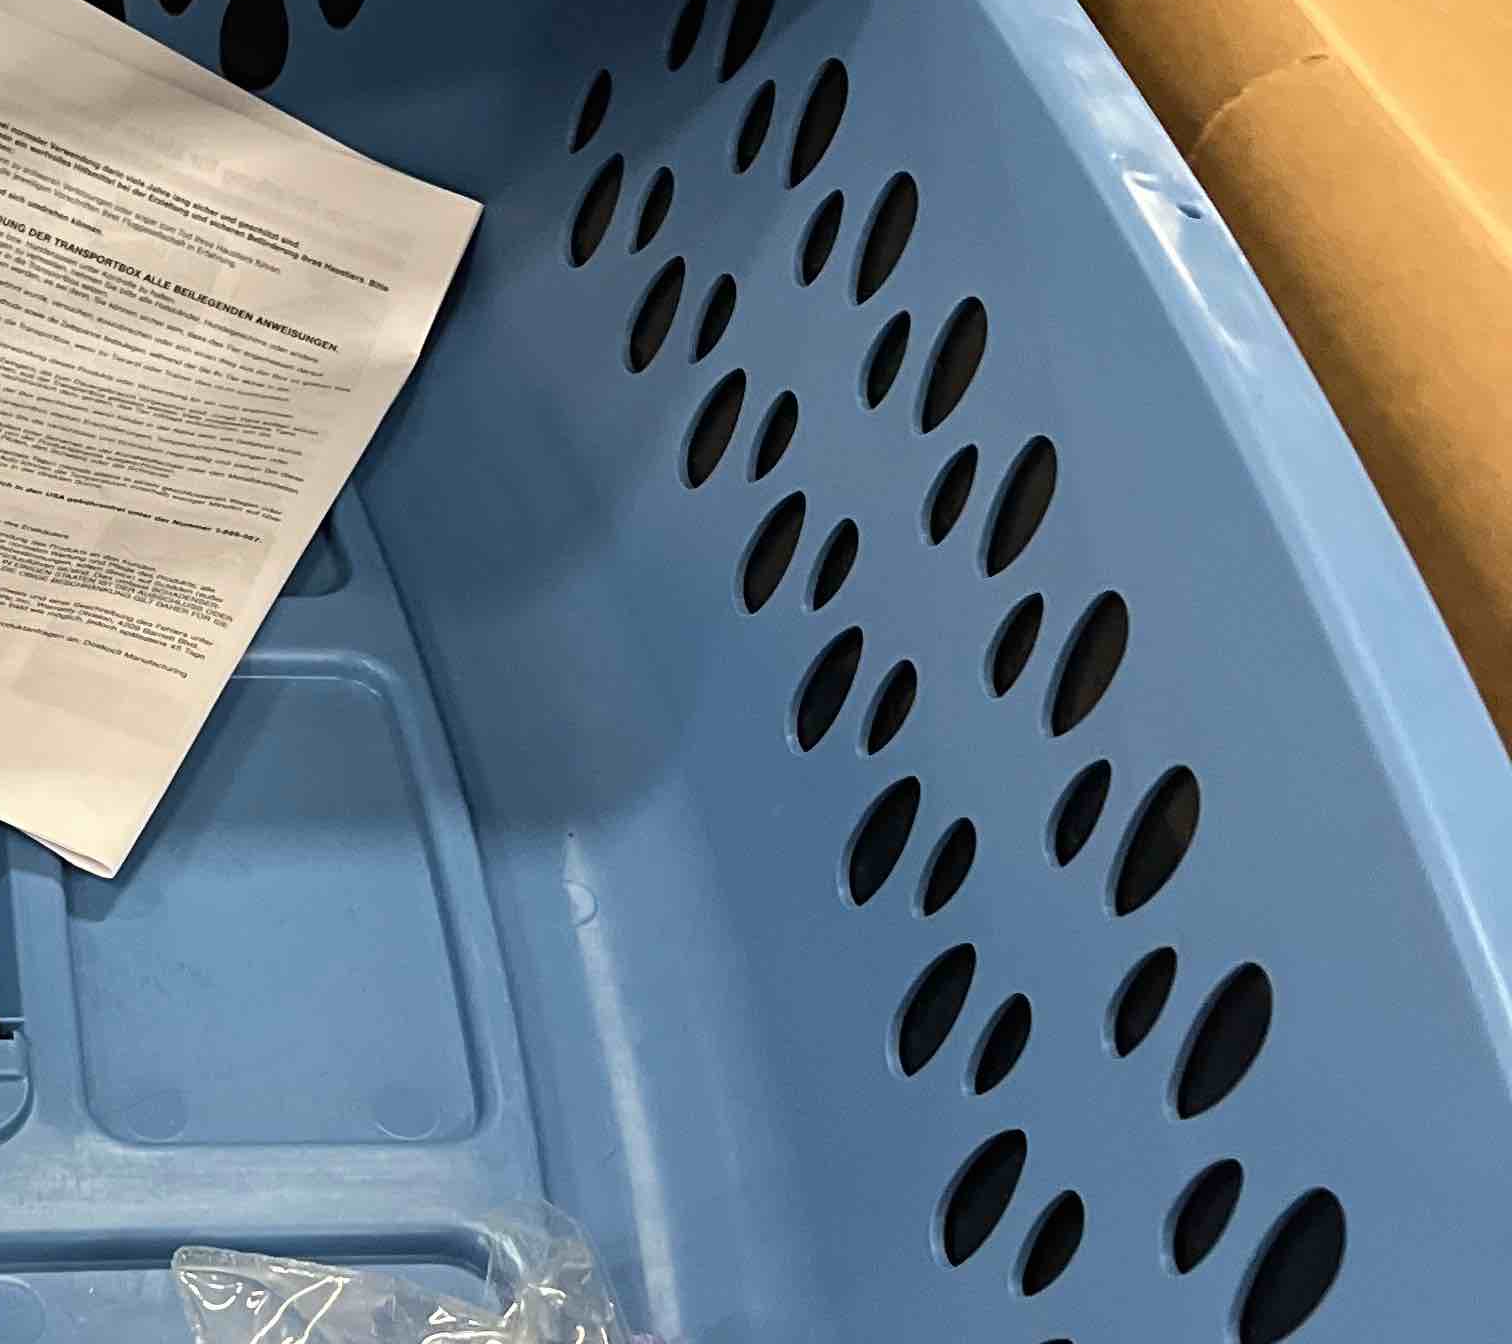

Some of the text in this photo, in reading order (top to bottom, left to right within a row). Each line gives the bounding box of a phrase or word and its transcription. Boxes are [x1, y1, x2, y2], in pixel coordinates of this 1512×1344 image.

[27, 226, 52, 244] DER
[52, 235, 142, 281] TRANSPORTBOX
[142, 272, 171, 291] ALLE
[172, 282, 253, 324] BEILIEGENDEN
